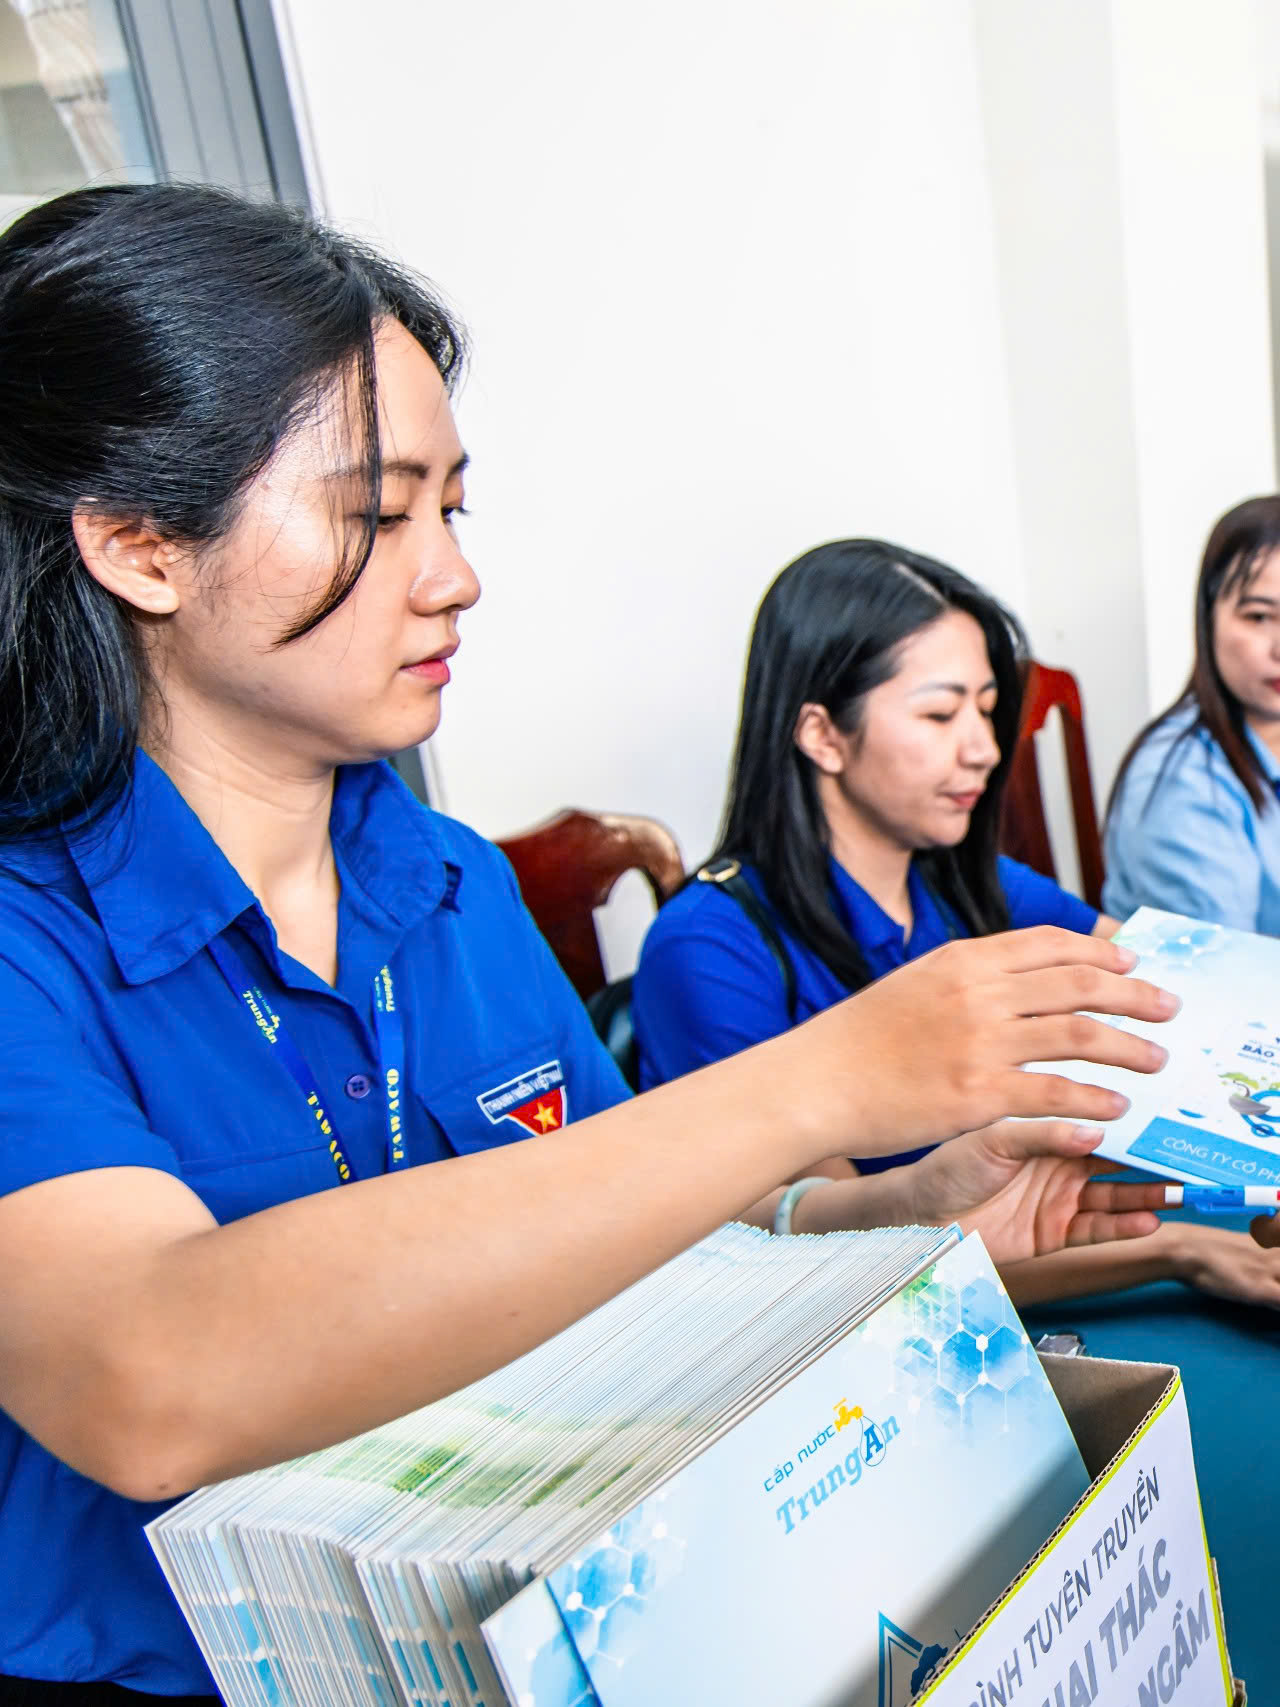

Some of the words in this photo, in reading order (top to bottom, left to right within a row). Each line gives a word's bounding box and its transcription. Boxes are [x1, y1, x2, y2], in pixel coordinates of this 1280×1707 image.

[1162, 1136, 1209, 1159] CÔNG
[1211, 1151, 1232, 1165] TY
[1023, 1558, 1091, 1669] TUYÊN
[1091, 1465, 1161, 1582] TRUYỀN
[1099, 1537, 1172, 1673] THÁC
